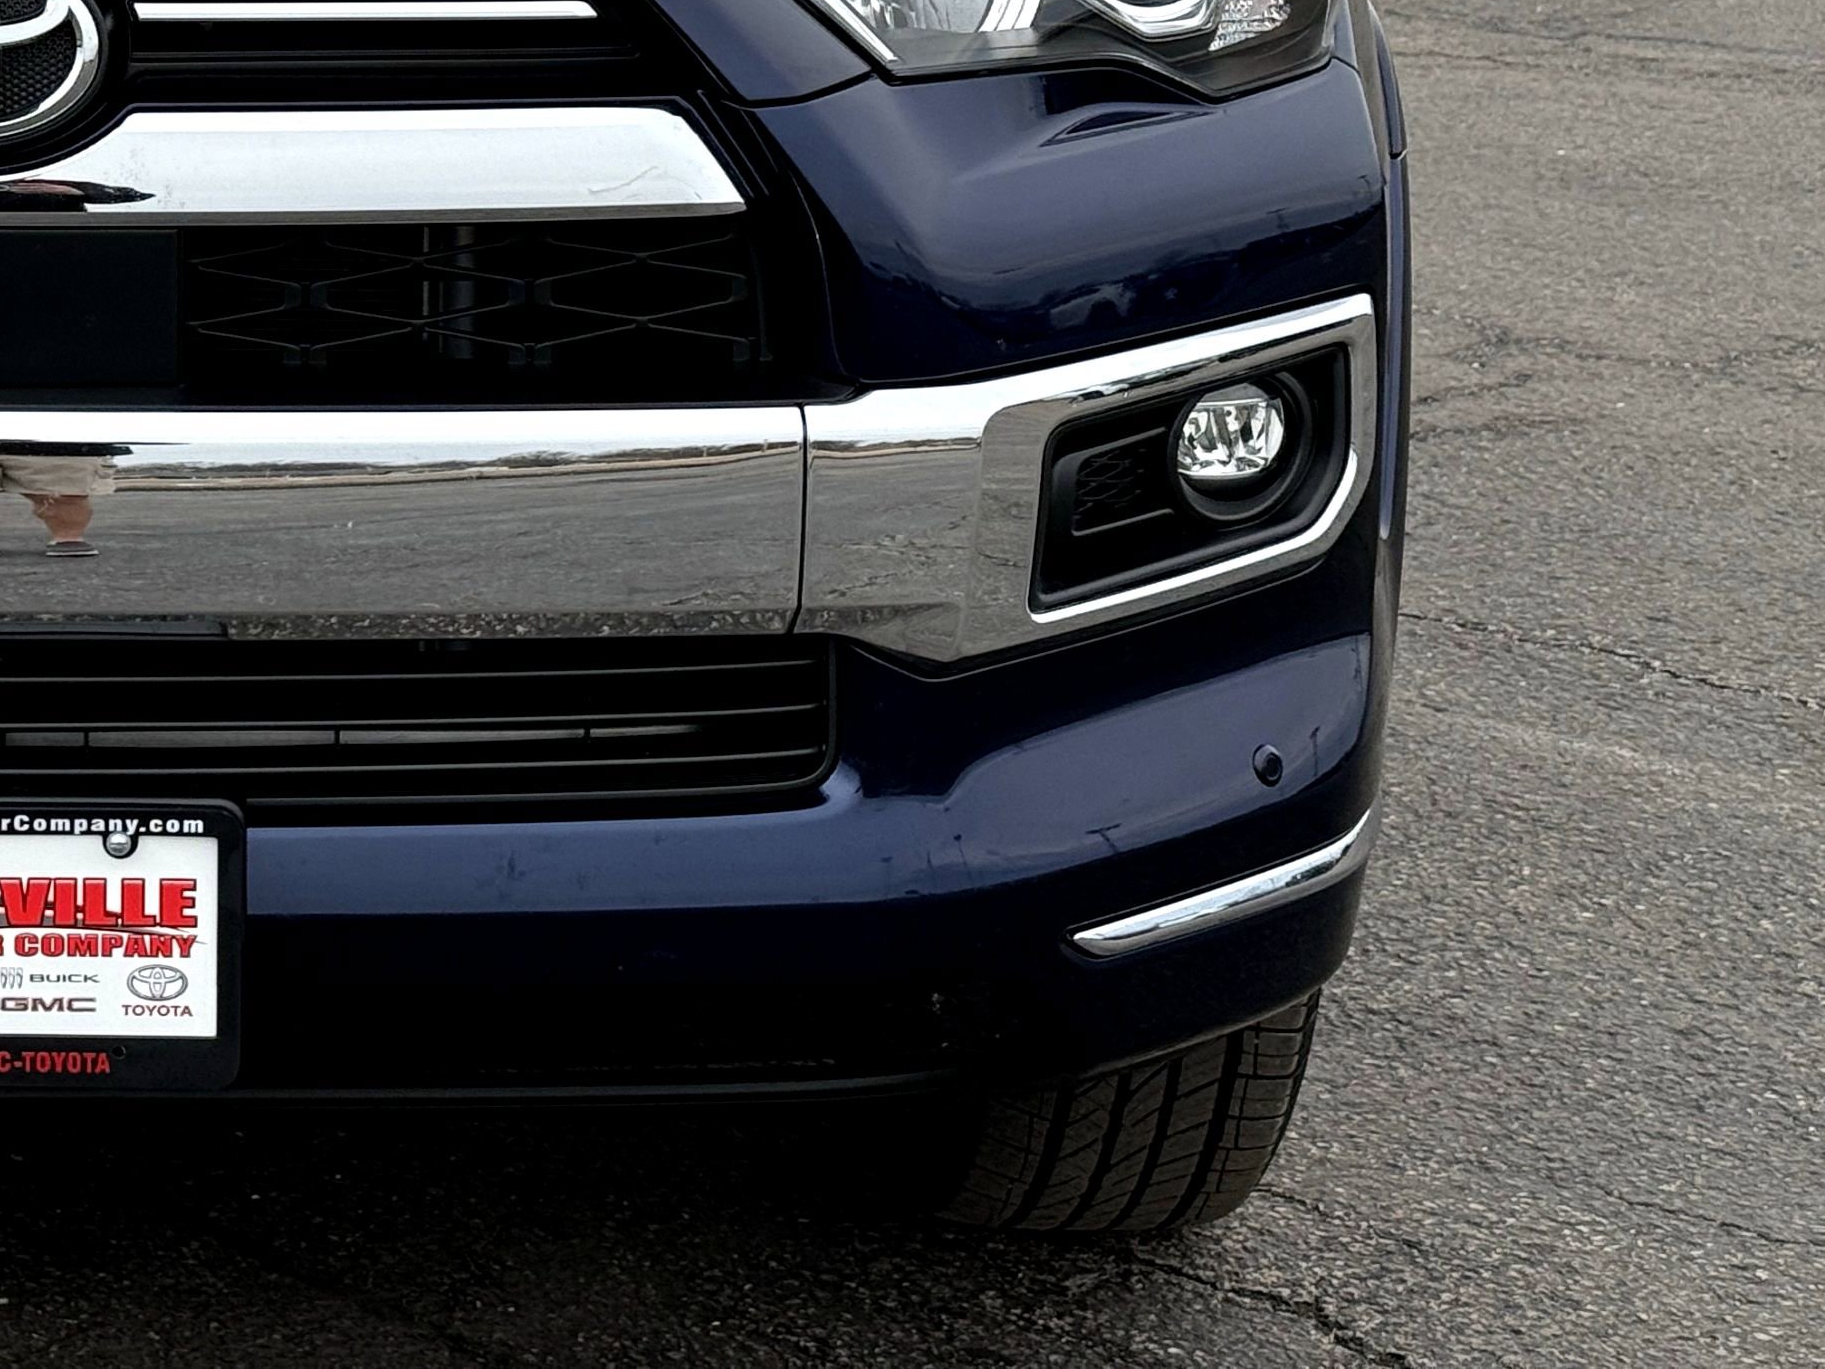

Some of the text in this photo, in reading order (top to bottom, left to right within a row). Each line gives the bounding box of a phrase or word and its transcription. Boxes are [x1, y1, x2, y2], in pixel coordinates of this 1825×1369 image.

[14, 933, 195, 958] COMPANY
[29, 973, 100, 984] BUICK
[0, 997, 96, 1012] GMC
[121, 1004, 193, 1017] TOYOTA
